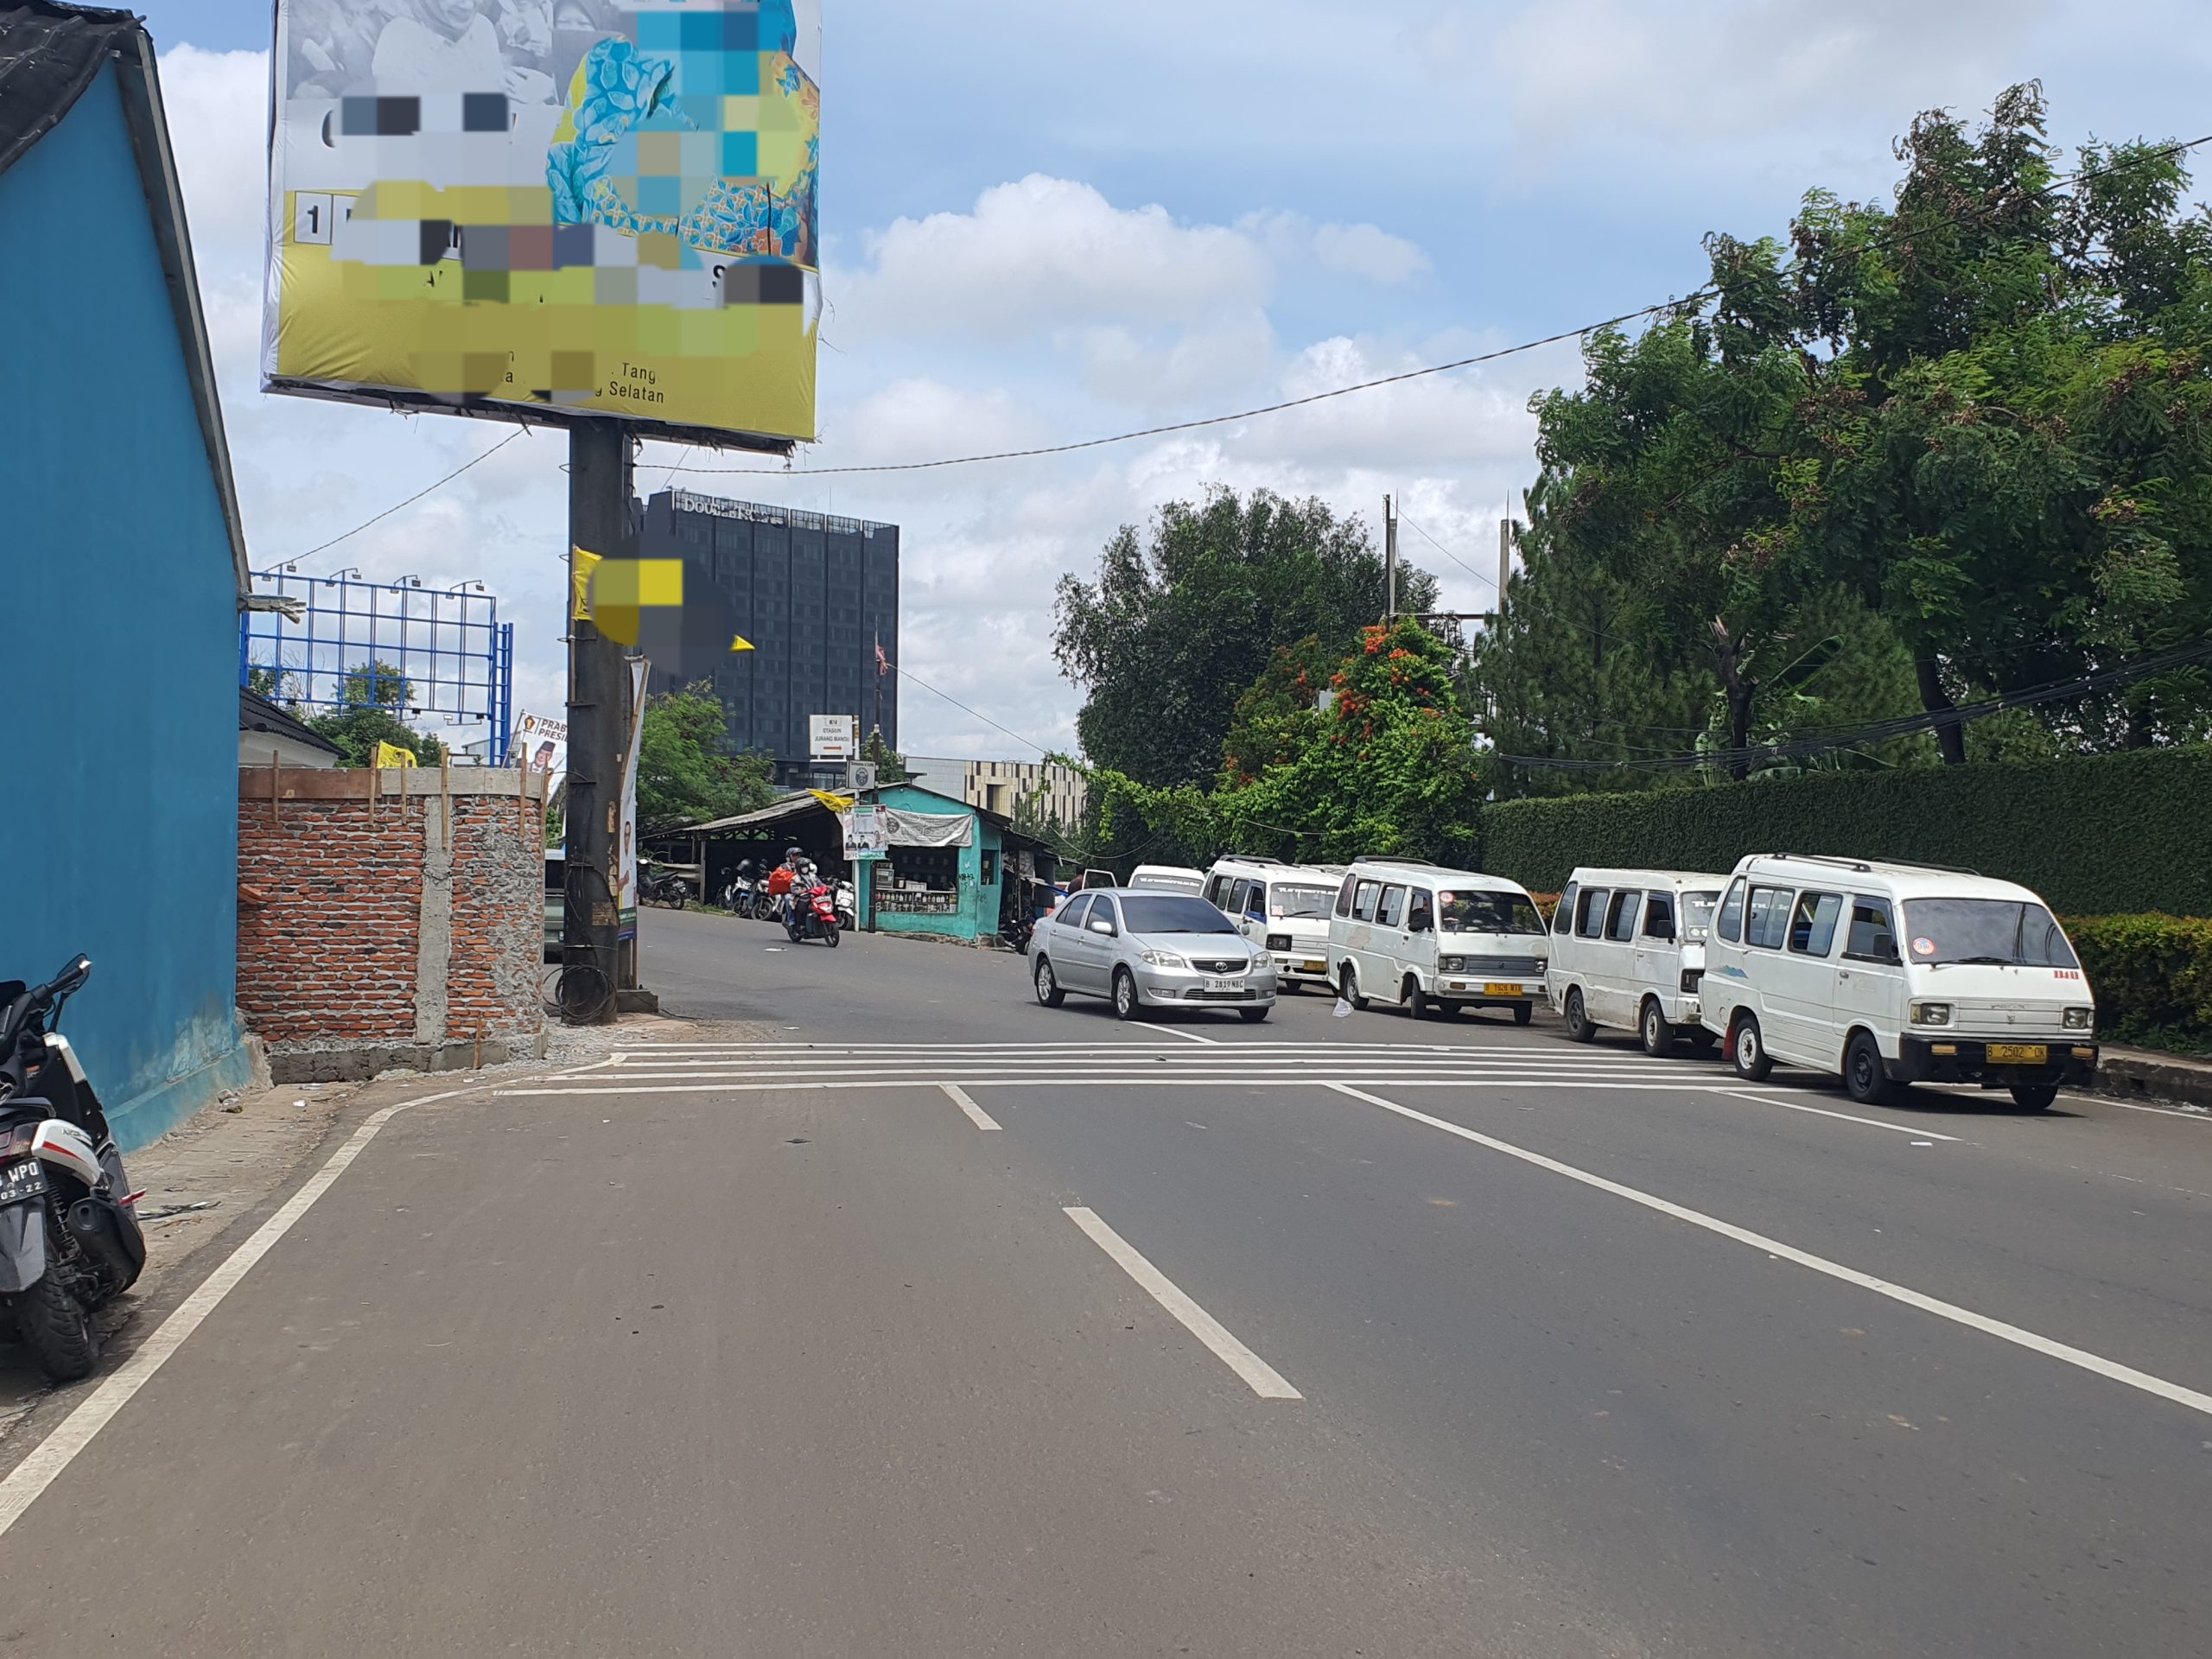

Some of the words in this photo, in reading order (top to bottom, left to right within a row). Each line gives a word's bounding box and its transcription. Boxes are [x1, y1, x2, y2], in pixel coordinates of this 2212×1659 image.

[609, 381, 664, 404] Selatan
[1987, 1046, 1993, 1057] B
[2002, 1046, 2024, 1058] 2502
